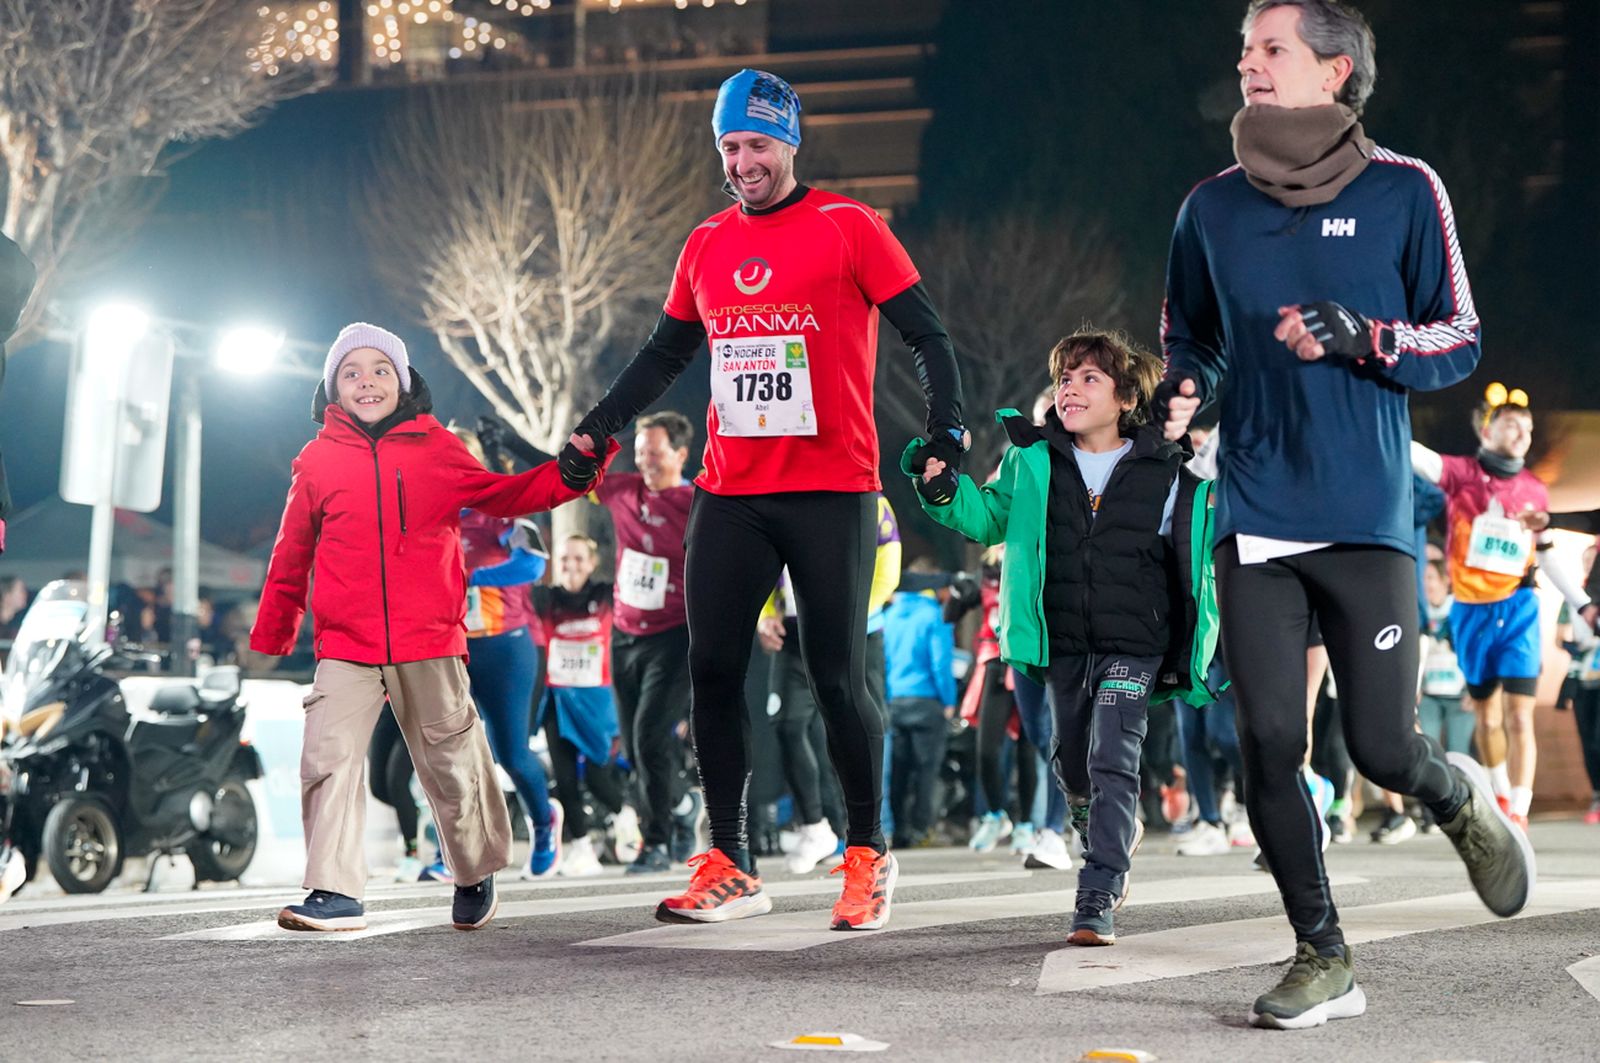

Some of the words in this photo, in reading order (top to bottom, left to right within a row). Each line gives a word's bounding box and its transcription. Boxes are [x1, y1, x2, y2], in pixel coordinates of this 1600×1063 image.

[1321, 218, 1356, 237] HH
[707, 303, 814, 317] AUTOESCUELA
[707, 313, 820, 336] JUANMA
[734, 348, 763, 359] NOCHE
[765, 347, 777, 358] DE
[723, 360, 741, 372] SAN
[733, 372, 792, 402] 1738
[755, 403, 769, 411] Abel
[1485, 537, 1518, 556] 8149
